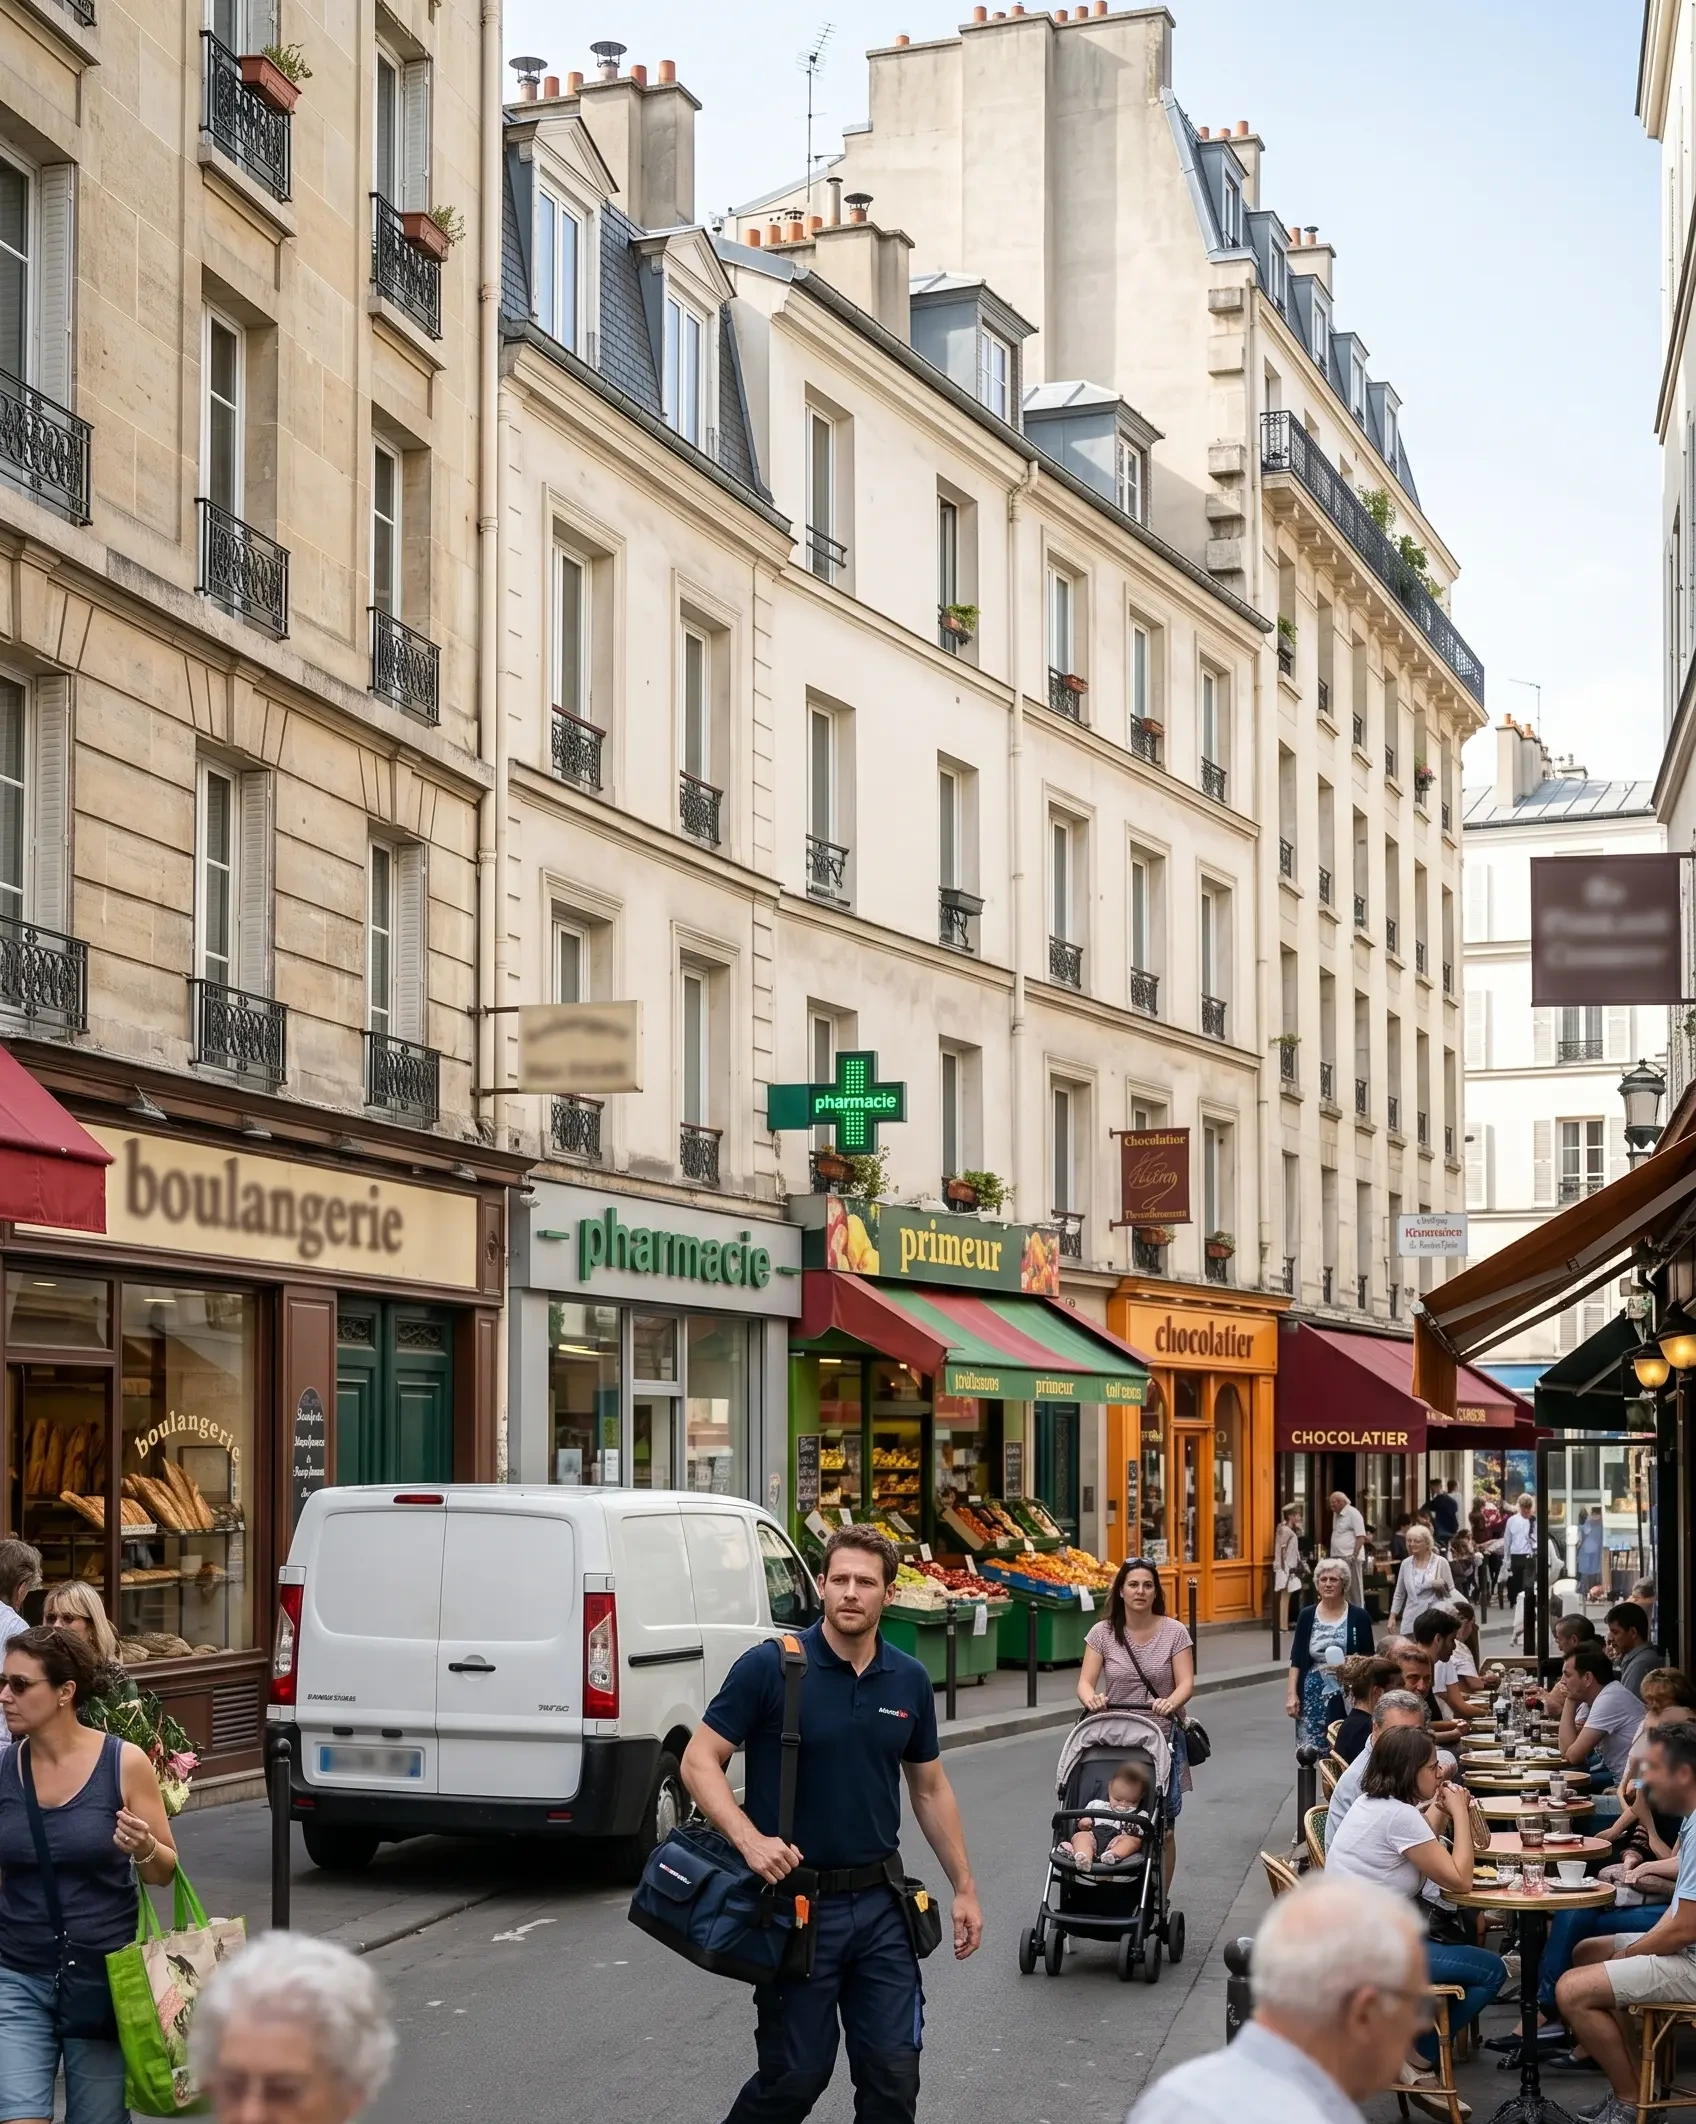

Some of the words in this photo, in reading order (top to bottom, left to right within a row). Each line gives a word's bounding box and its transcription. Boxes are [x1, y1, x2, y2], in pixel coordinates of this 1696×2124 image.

[815, 1093, 896, 1113] pharmacie
[124, 1137, 404, 1260] boulangerie
[578, 1207, 771, 1289] pharmacie
[900, 1219, 1002, 1273] primeur
[1155, 1315, 1254, 1358] chocolatier
[134, 1410, 240, 1462] boulangerie
[1291, 1430, 1409, 1446] CHOCOLATIER
